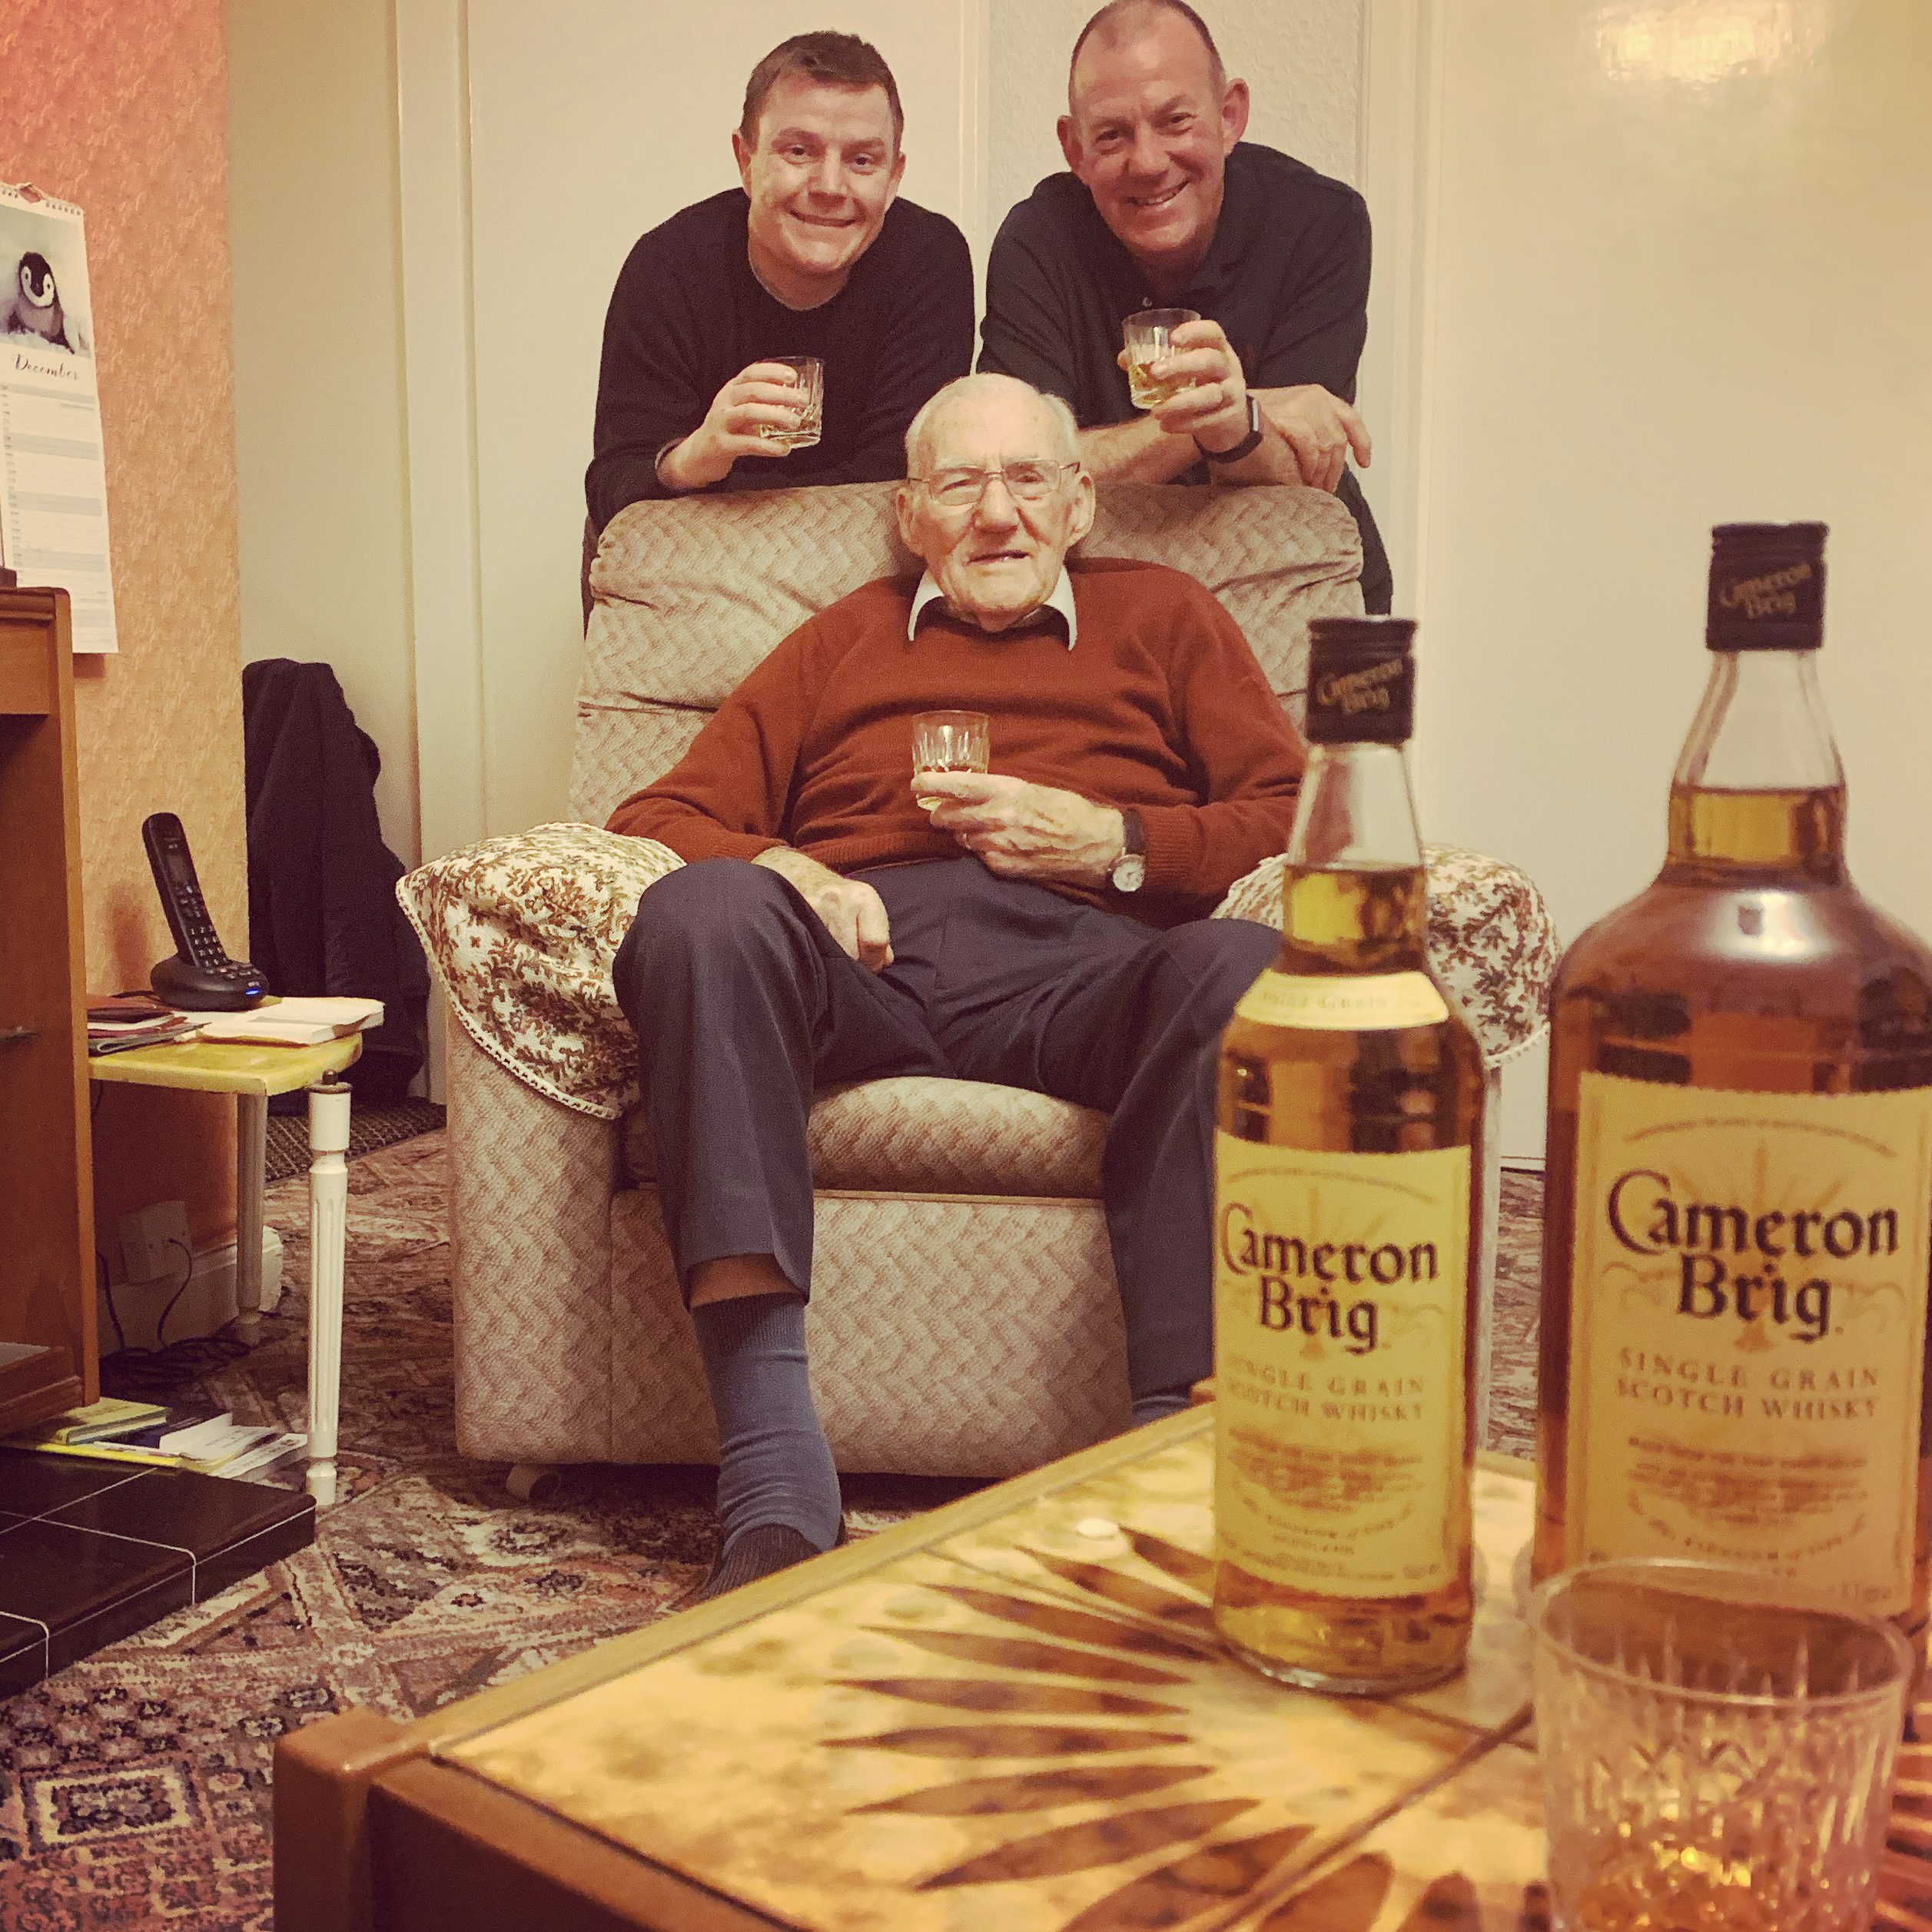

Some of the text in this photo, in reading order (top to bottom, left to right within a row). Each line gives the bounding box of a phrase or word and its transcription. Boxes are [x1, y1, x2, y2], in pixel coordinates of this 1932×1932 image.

[13, 353, 80, 381] December
[1608, 1168, 1900, 1259] Cameron
[1220, 1202, 1439, 1284] Cameron
[1260, 1274, 1379, 1356] Brig
[1327, 1374, 1424, 1398] GRAIN
[1619, 1346, 1879, 1391] SINGLE GRAIN
[1616, 1374, 1880, 1420] SCOTCH WHISKY
